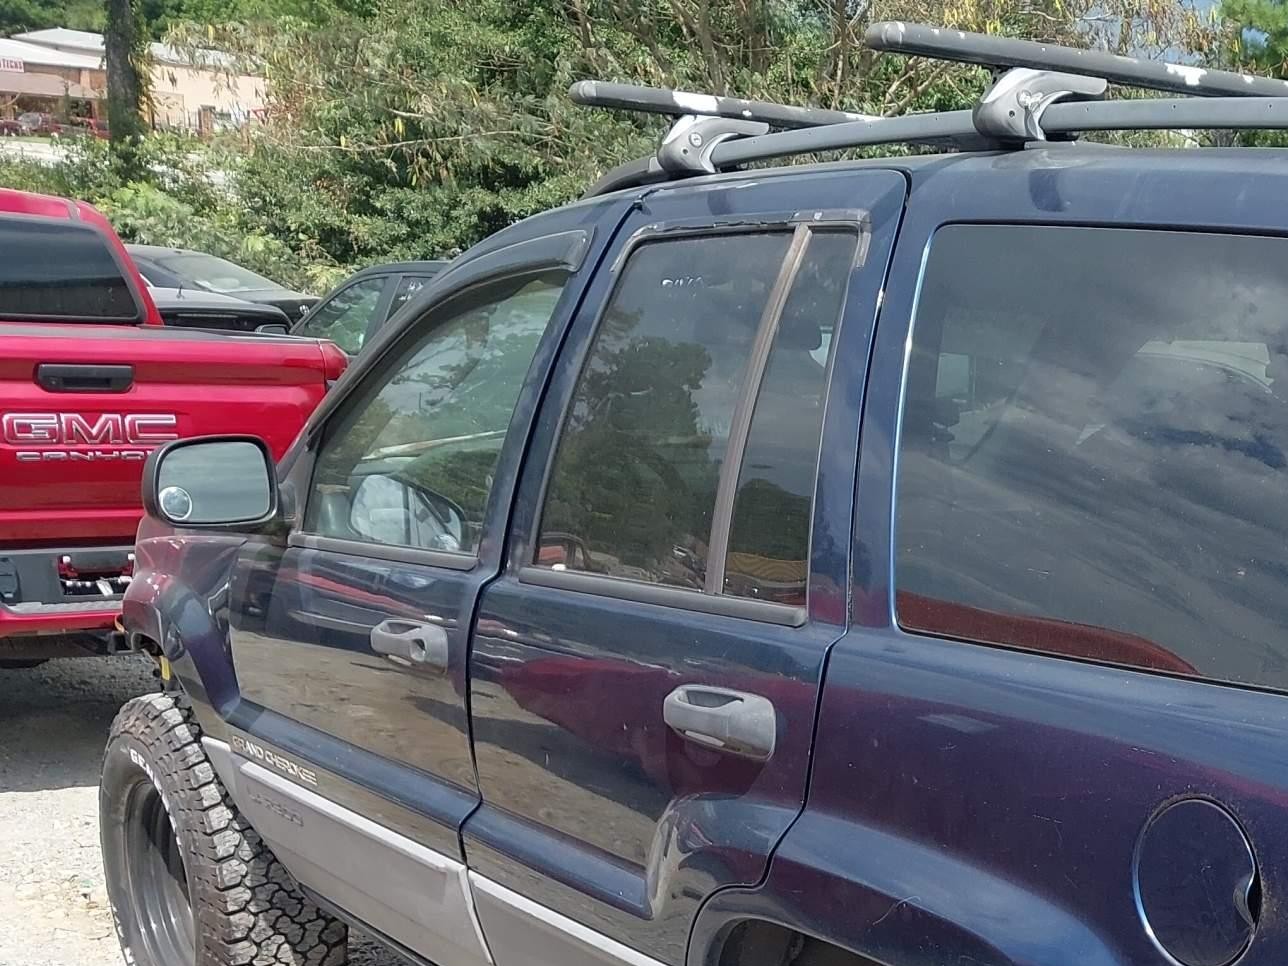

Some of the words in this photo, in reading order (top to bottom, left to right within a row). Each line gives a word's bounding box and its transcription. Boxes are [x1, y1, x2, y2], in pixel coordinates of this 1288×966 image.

[2, 413, 178, 444] GMC
[16, 450, 152, 462] CANYO
[232, 735, 264, 760] GRAND
